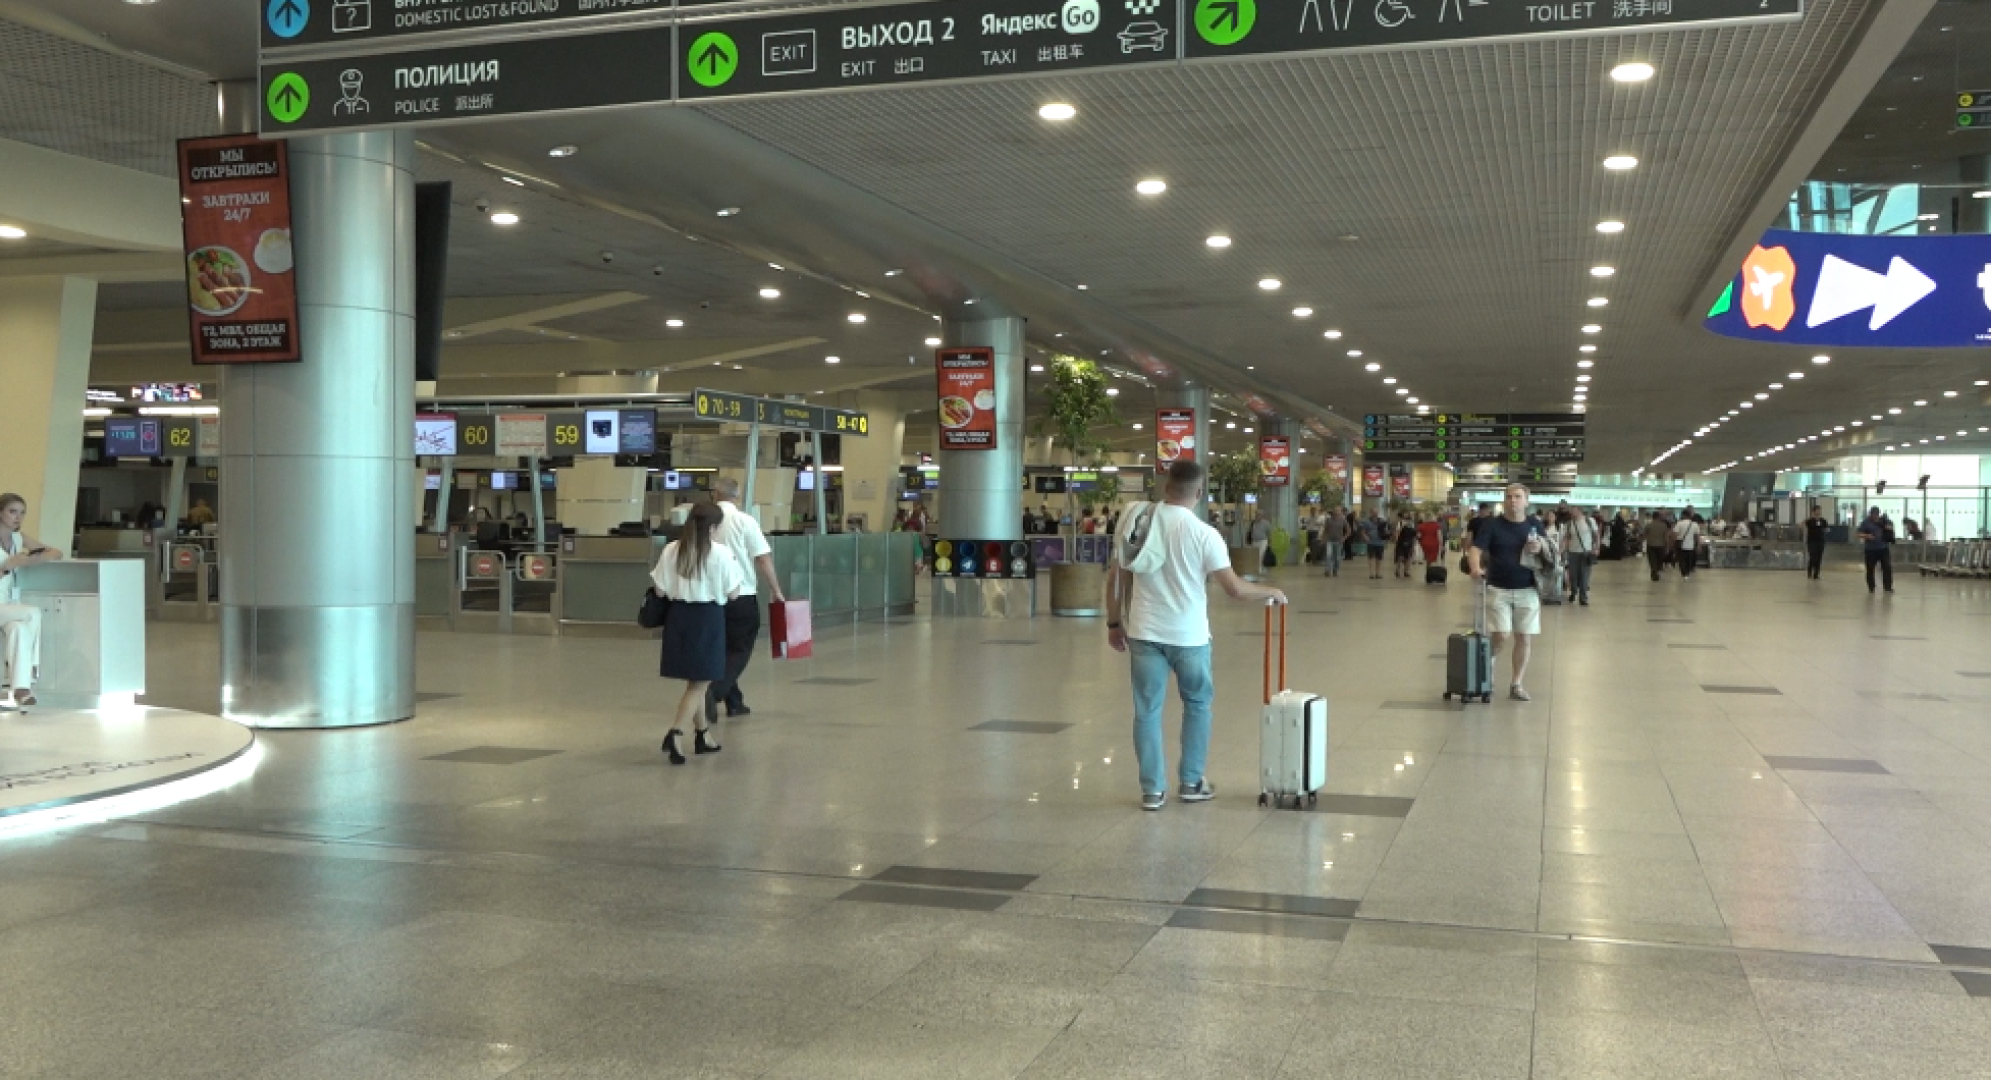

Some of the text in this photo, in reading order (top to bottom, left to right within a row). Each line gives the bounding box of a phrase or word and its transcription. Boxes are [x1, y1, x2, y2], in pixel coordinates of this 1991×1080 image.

[394, 8, 462, 28] DOMESTIC
[981, 6, 1095, 36] Яндекс Go
[1526, 2, 1596, 23] TOILET
[841, 17, 955, 49] ВЫХОД 2
[769, 44, 807, 62] EXIT
[981, 49, 1018, 66] TAXI
[1038, 44, 1084, 62] 出租车
[394, 59, 499, 90] ПОЛИЦИЯ
[841, 60, 877, 77] EXIT
[894, 56, 924, 74] 出口
[394, 97, 441, 115] POLICE
[220, 148, 244, 163] МЫ
[191, 160, 278, 180] ОТКРЫЛИСЬ!
[202, 190, 270, 209] ЗАВТРАКИ
[223, 207, 251, 222] 24/7
[170, 428, 191, 447] 62
[464, 425, 488, 446] 60
[554, 425, 580, 446] 59
